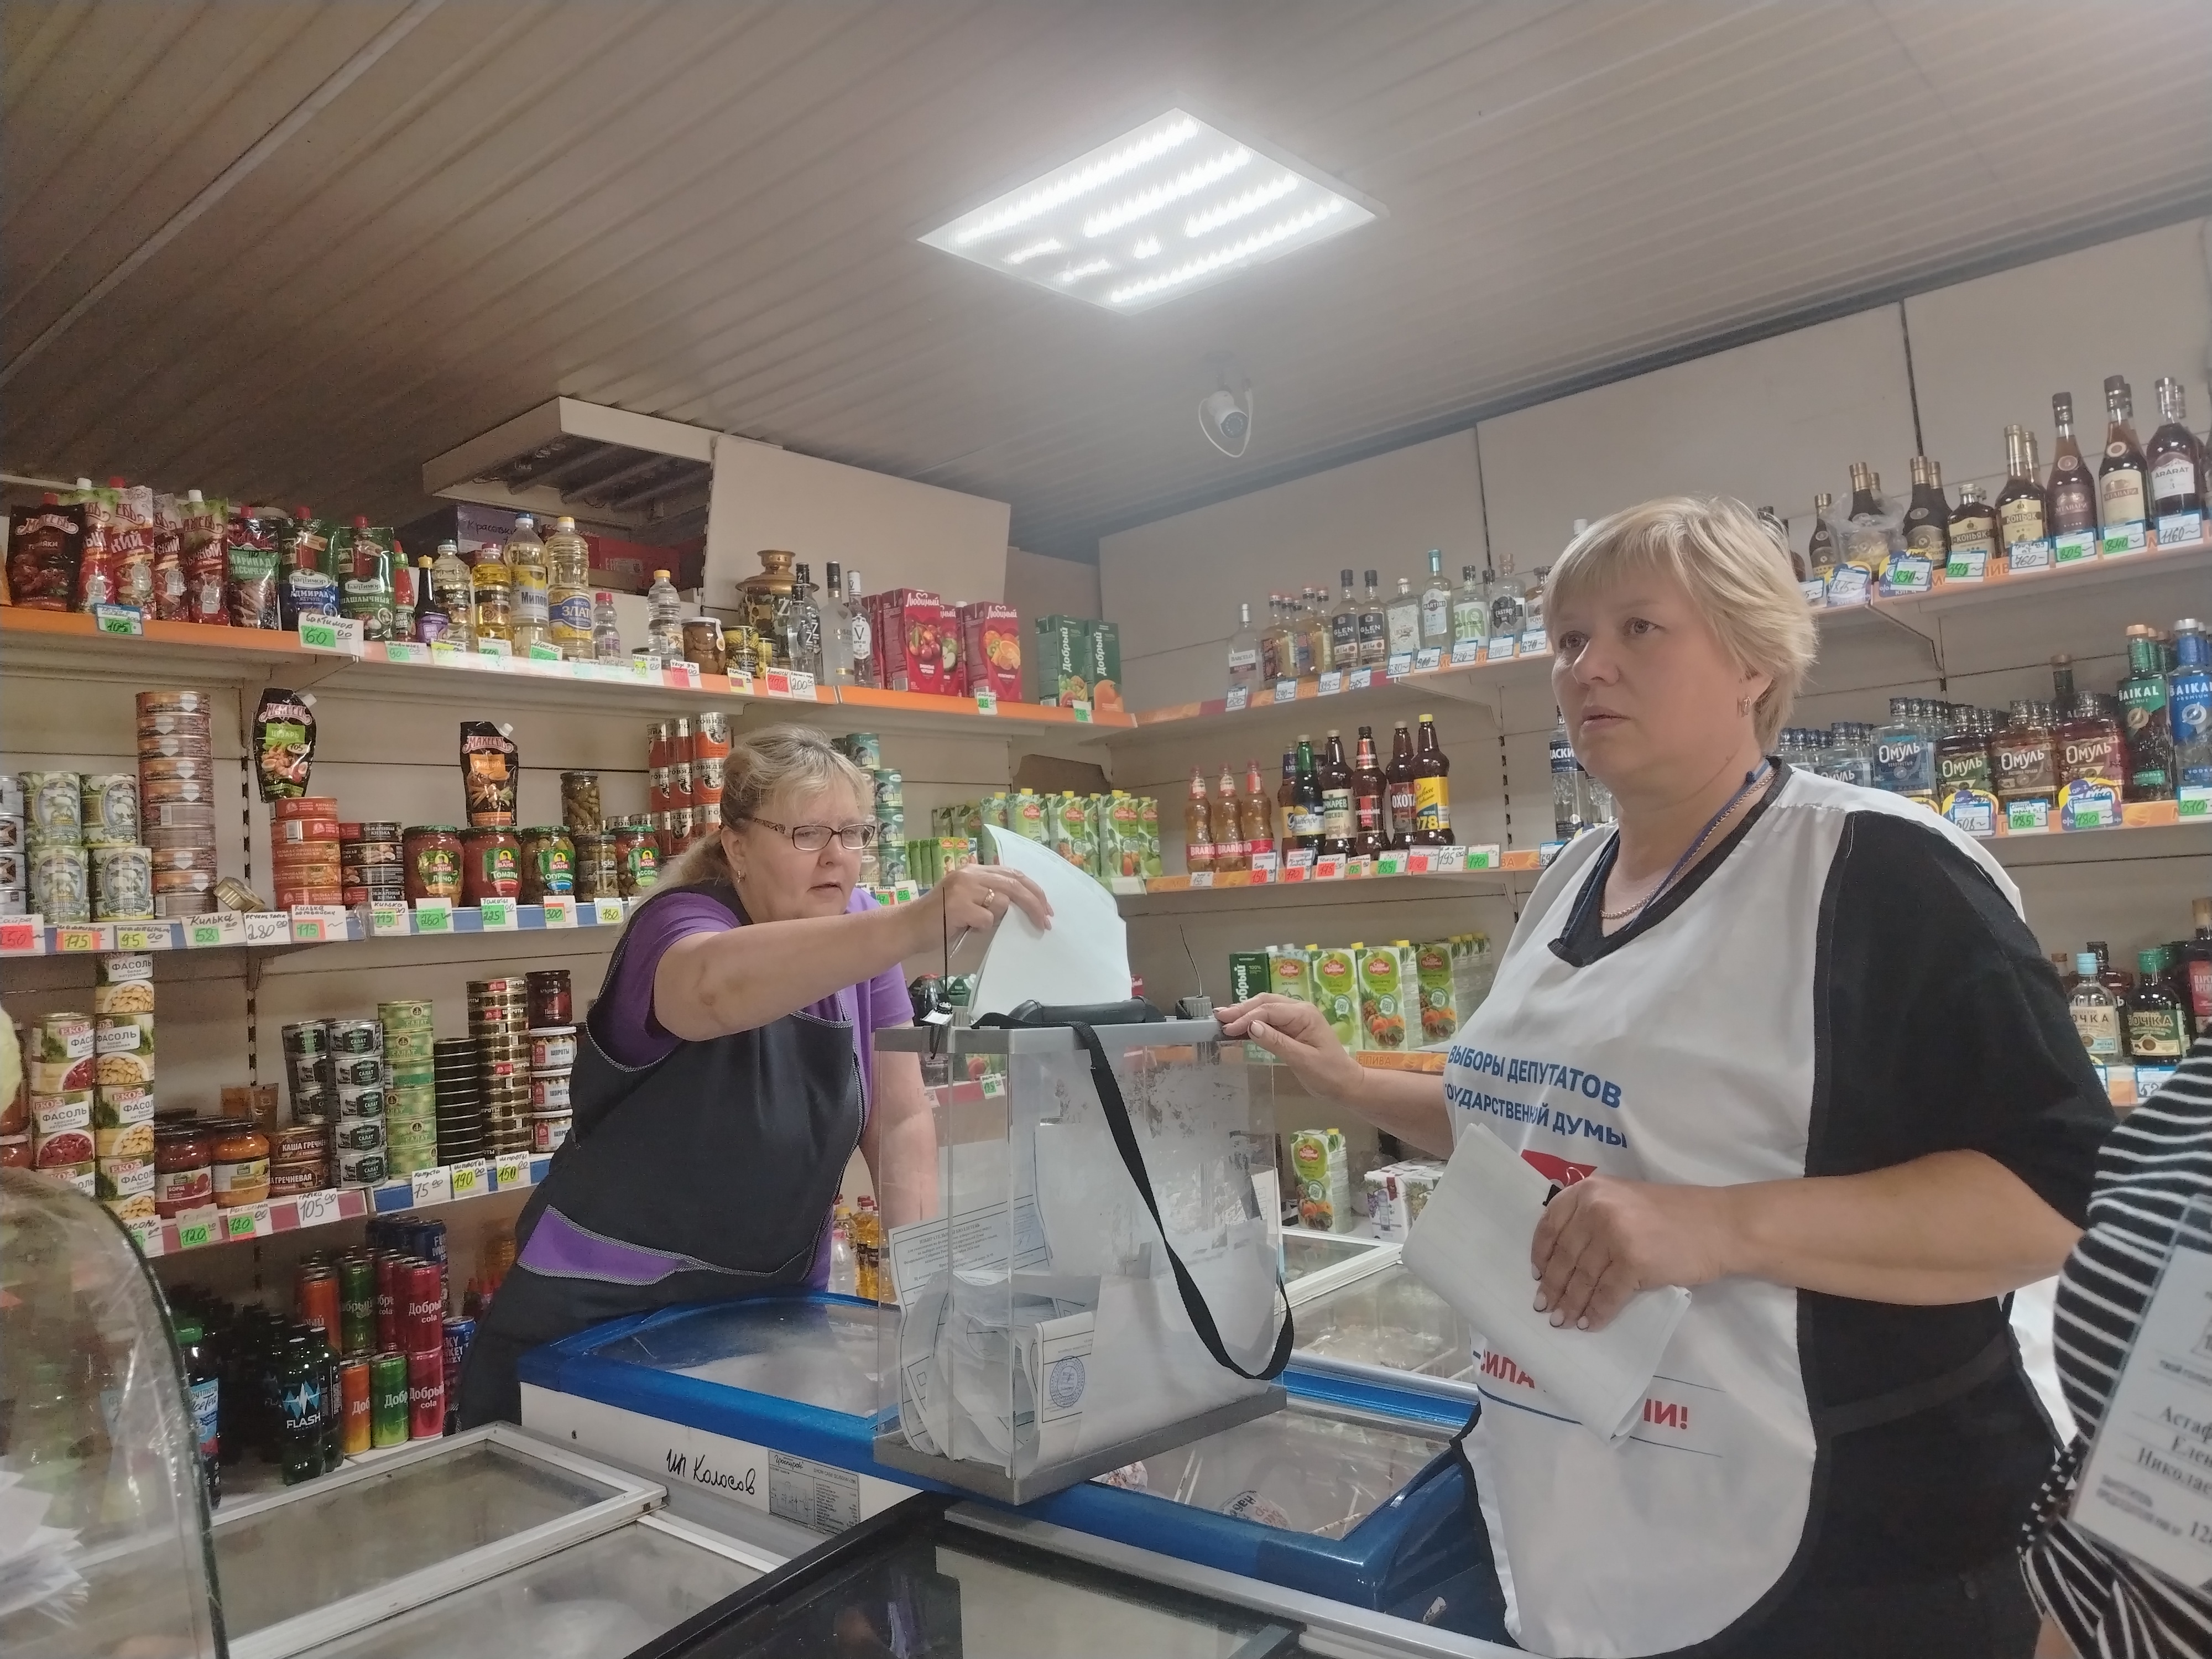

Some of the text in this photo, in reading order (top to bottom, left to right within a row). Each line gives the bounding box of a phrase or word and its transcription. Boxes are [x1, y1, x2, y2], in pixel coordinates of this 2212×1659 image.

[2156, 468, 2189, 479] ARARAT
[2007, 512, 2037, 523] КОНЬЯК
[1954, 532, 1987, 544] КОНЬЯК
[2015, 555, 2036, 567] 760
[290, 589, 328, 599] АДМИРАЛ
[905, 592, 940, 608] Любимый
[1423, 600, 1446, 610] MARTINI
[986, 604, 1018, 619] Любимый
[1333, 626, 1354, 637] GLEN
[1360, 624, 1381, 633] GLEN
[305, 633, 327, 644] 60
[531, 640, 560, 653] Масло
[1060, 626, 1073, 672] Добрый
[389, 649, 403, 658] 90
[1095, 631, 1108, 676] Добрый
[1453, 651, 1467, 661] 720
[1389, 663, 1402, 674] 680
[792, 678, 807, 690] 200
[2119, 685, 2159, 702] BAIKAL
[1879, 743, 1921, 763] Омуль
[2066, 742, 2112, 764] Омуль
[2001, 749, 2045, 770] Омуль
[1942, 757, 1983, 778] Омуль
[1439, 852, 1454, 865] 195
[431, 874, 452, 883] Лечо
[491, 870, 518, 879] Томаты
[545, 873, 573, 881] Огурчики
[545, 910, 562, 919] 300
[603, 910, 619, 920] 180
[189, 915, 235, 927] Килька
[195, 928, 218, 942] 58
[248, 925, 275, 941] 280
[65, 931, 89, 948] 175
[121, 934, 140, 947] 95
[111, 959, 153, 971] ФАСОЛЬ
[96, 1031, 137, 1043] ФАСОЛЬ
[1365, 1056, 1391, 1066] ПИВА
[1447, 1045, 1622, 1109] ВЫБОРЫ ДЕПУТАТОВ
[42, 1107, 87, 1122] ФАСОЛЬ
[1552, 1111, 1627, 1149] ДУМЫ
[283, 1142, 302, 1152] КАША
[275, 1172, 312, 1184] ГРЕЧНЕВАЯ
[455, 1171, 473, 1187] 190
[498, 1166, 517, 1180] 150
[415, 1182, 428, 1197] 75
[300, 1199, 325, 1218] 105
[421, 1314, 437, 1323] cola
[421, 1399, 437, 1408] cola
[286, 1412, 321, 1429] FLASH
[667, 1448, 756, 1495] ИП Колосов
